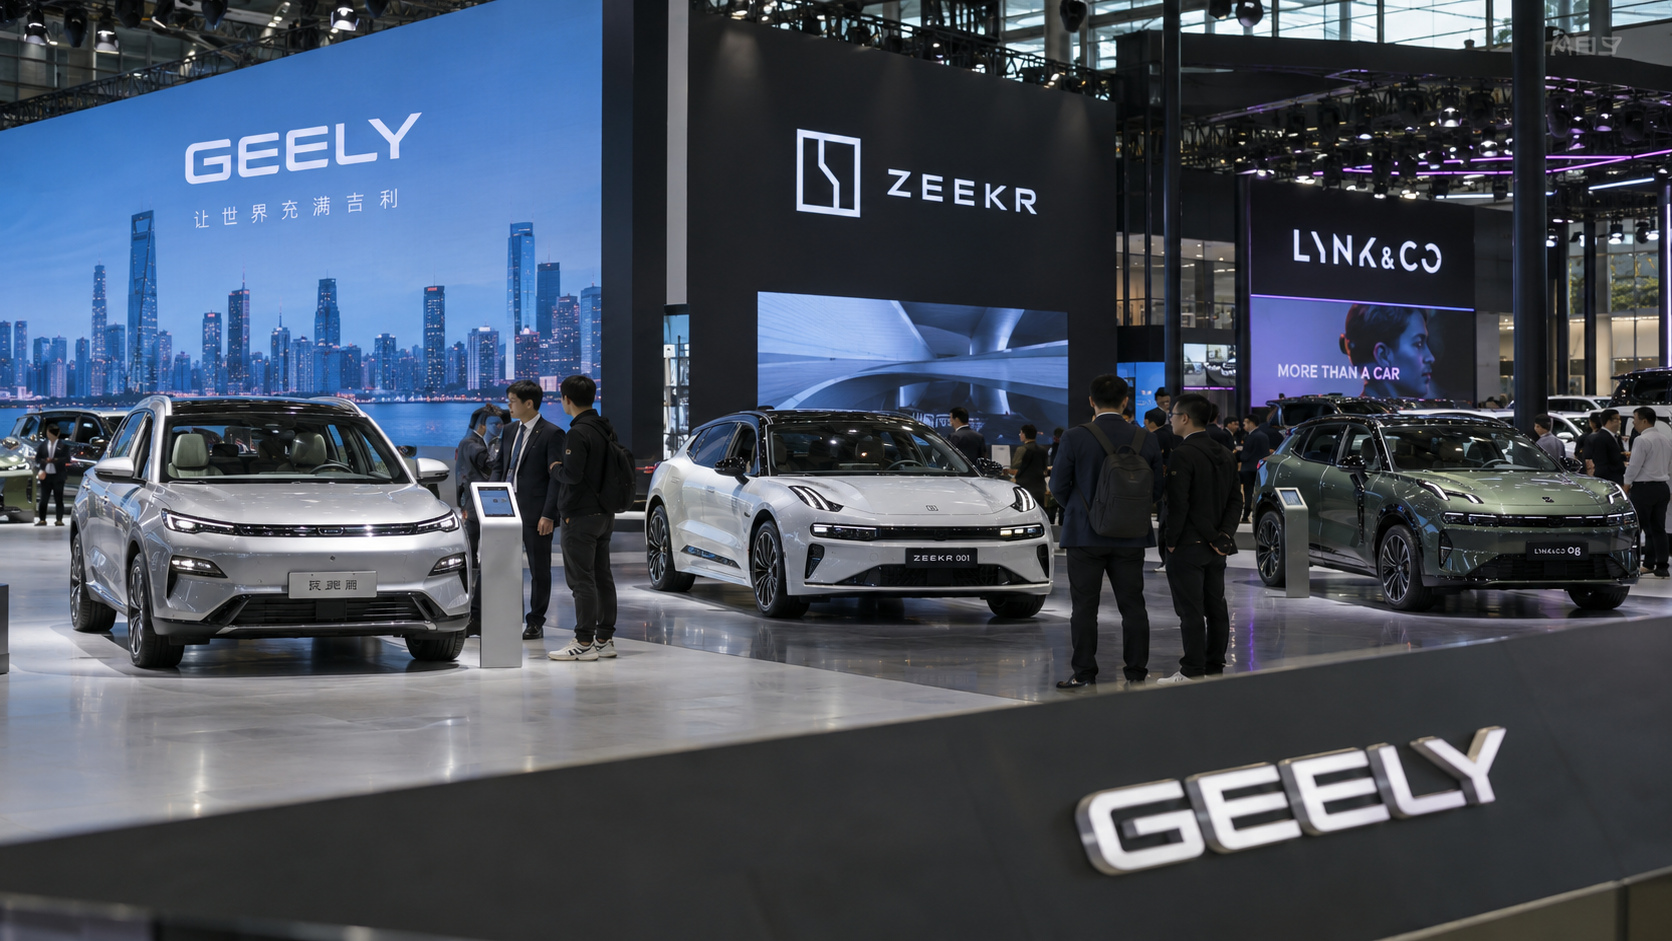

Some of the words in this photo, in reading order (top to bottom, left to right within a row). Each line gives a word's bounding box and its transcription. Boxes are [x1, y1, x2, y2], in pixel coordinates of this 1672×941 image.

[185, 112, 422, 185] GEELY
[194, 188, 398, 229] 让世界充满吉利
[887, 168, 1038, 215] ZEEKR
[1293, 229, 1442, 274] LYNK&CO
[1277, 363, 1318, 378] MORE
[1321, 364, 1358, 379] THAN
[1361, 367, 1370, 380] A
[1373, 367, 1400, 380] CAR
[913, 554, 953, 562] ZEEKR
[955, 554, 970, 562] 001
[1567, 546, 1581, 557] 08
[1076, 726, 1507, 875] GEELY
